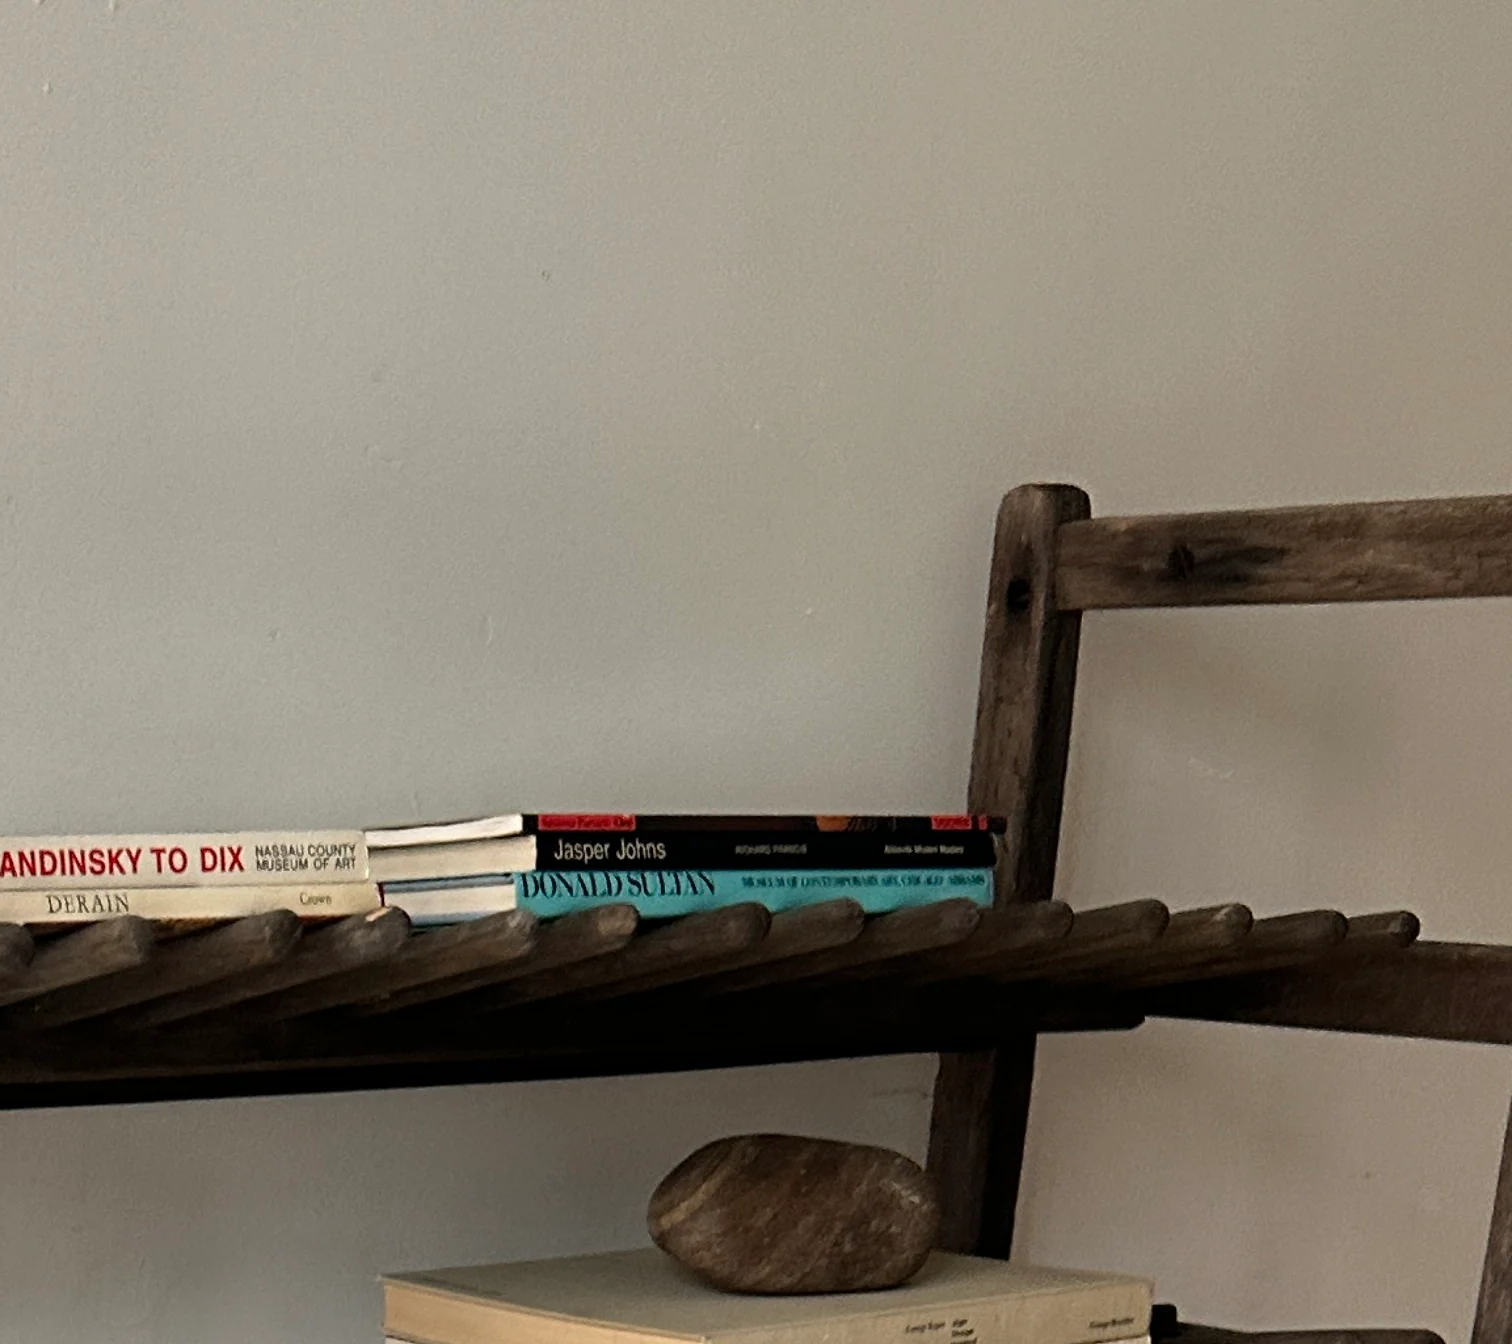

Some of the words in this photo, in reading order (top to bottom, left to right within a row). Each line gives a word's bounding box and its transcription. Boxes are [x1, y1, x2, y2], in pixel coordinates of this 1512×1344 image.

[150, 847, 187, 874] TO
[200, 846, 245, 873] DIX
[255, 844, 304, 858] NASSAU
[308, 844, 356, 858] COUNTY
[554, 838, 610, 864] Jasper
[616, 838, 667, 860] Johns
[256, 857, 309, 871] MUSEUM
[313, 857, 329, 871] OF
[334, 857, 356, 870] ART
[520, 871, 622, 898] DONALD
[626, 871, 716, 897] SULTAN
[46, 892, 129, 914] DERAIN
